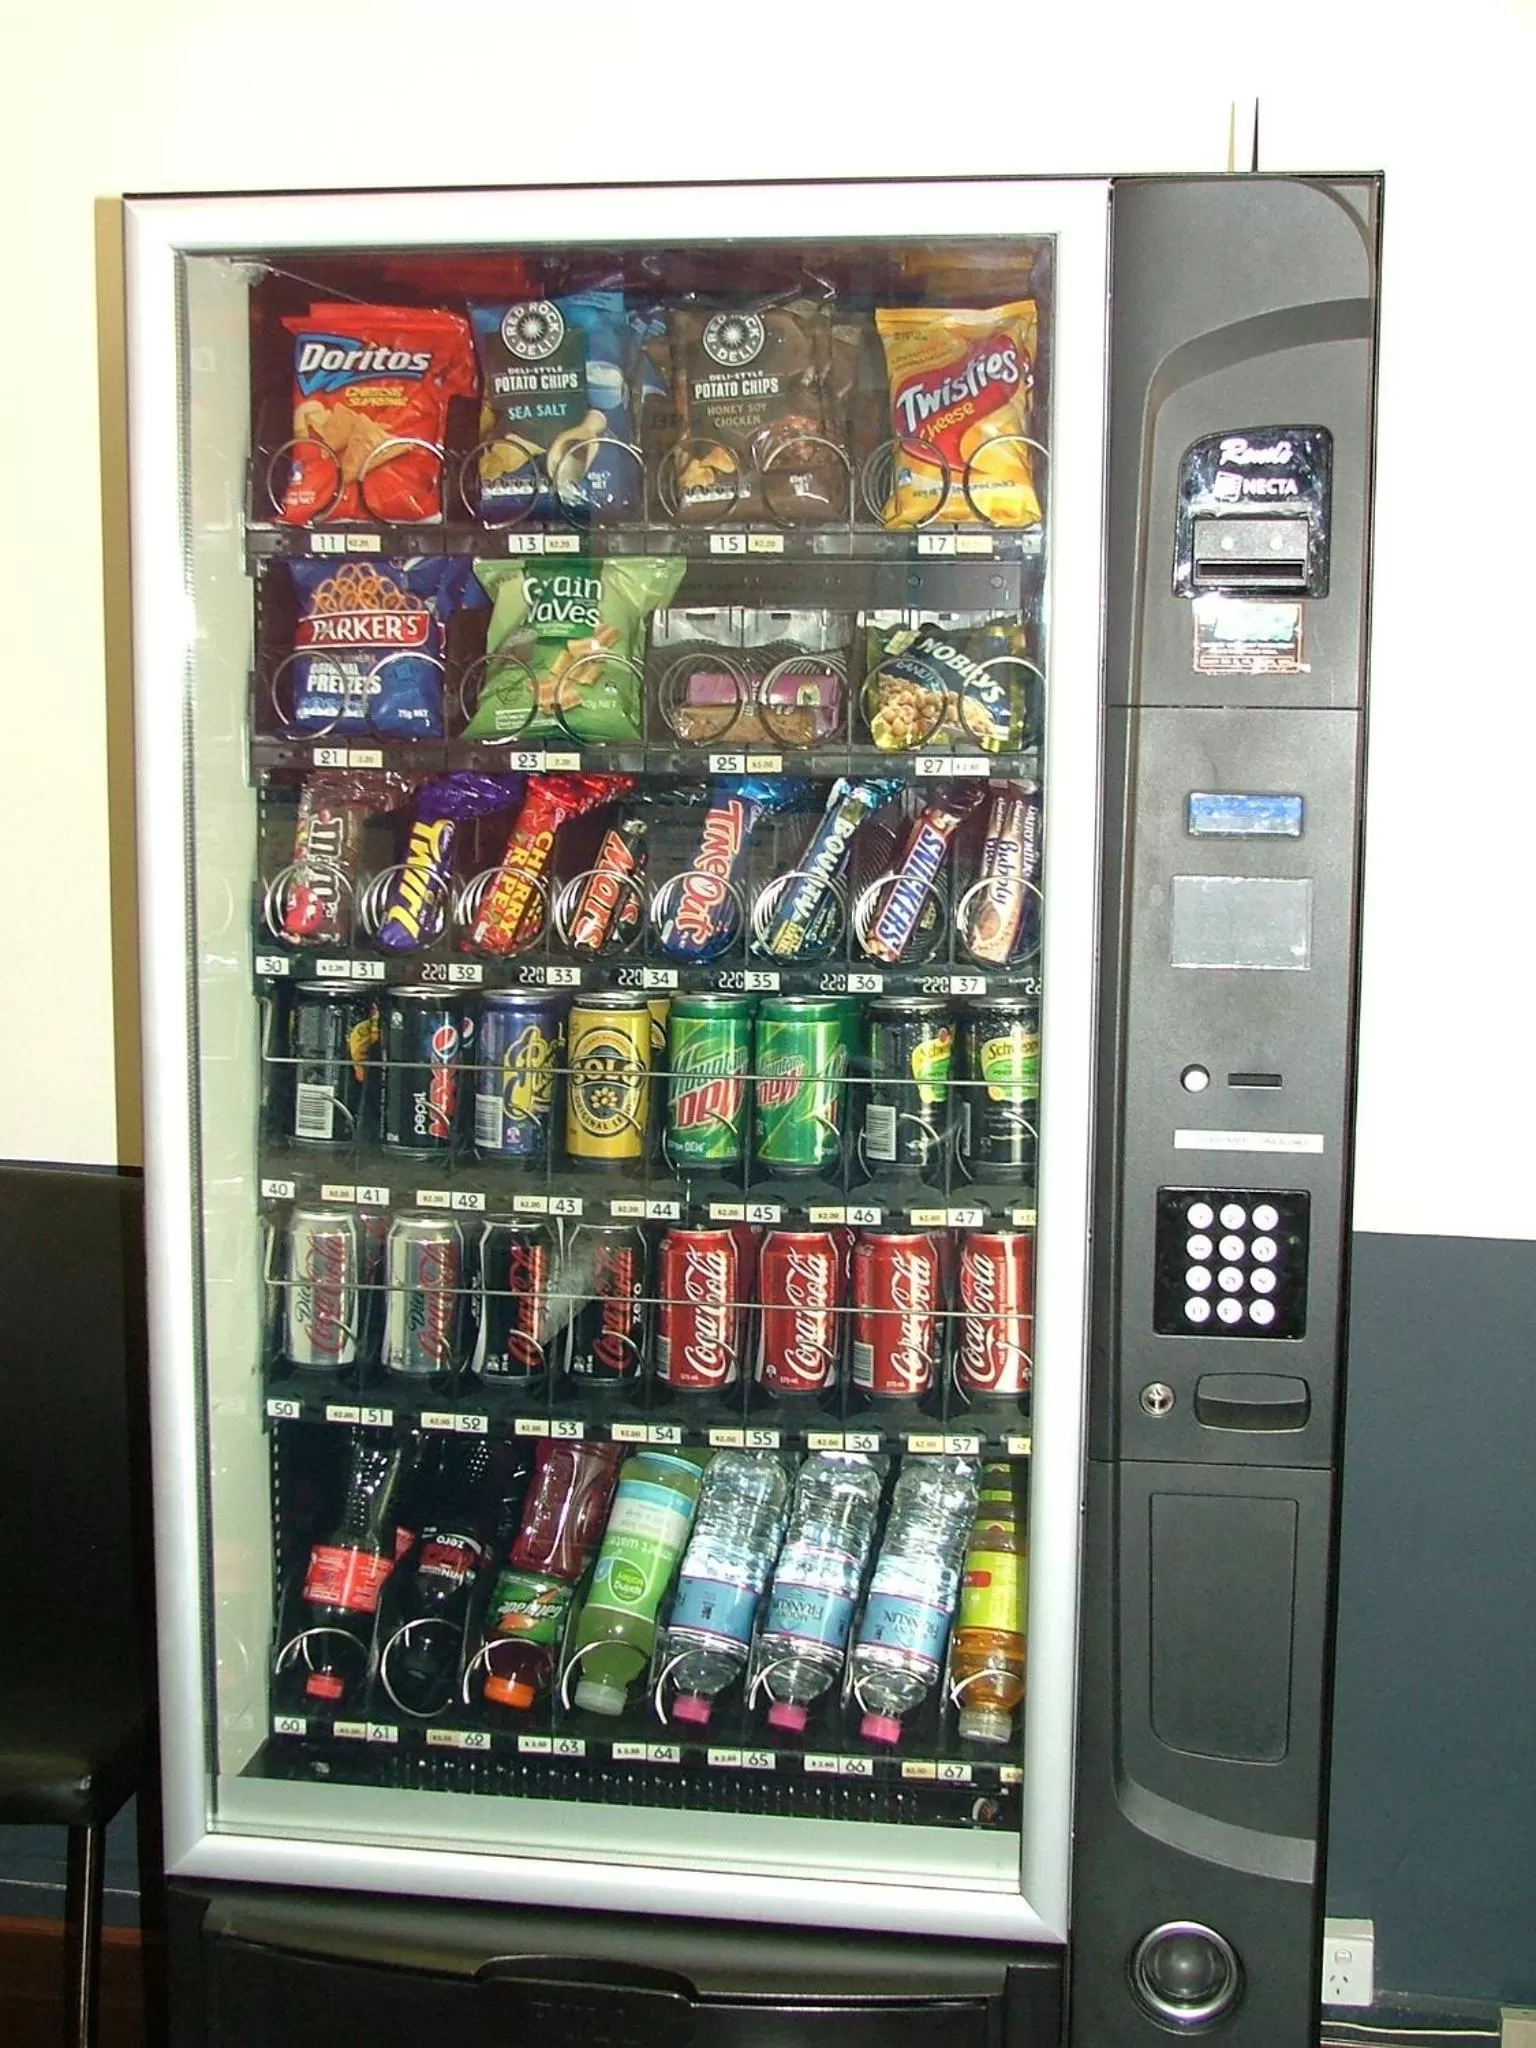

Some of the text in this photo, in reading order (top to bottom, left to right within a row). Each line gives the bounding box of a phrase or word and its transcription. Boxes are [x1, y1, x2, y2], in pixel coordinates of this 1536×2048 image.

[529, 302, 560, 332] ROCK
[515, 339, 553, 356] DELI
[717, 345, 754, 362] DELI
[298, 343, 432, 373] Doritos
[494, 373, 578, 393] POTATO CHIPS
[694, 377, 779, 399] POTATO CHIPS
[896, 350, 1018, 433] Twisties
[508, 403, 567, 421] SEA SALT
[706, 404, 744, 416] HONEY
[1242, 478, 1299, 496] NECTA
[319, 536, 337, 551] 11
[516, 536, 538, 552] 13
[719, 537, 739, 551] 15
[927, 537, 947, 551] 17
[311, 615, 418, 641] PARKER'S
[320, 750, 338, 765] 21
[518, 752, 538, 768] 23
[716, 756, 737, 771] 25
[923, 758, 943, 774] 27
[876, 827, 946, 951] SNICKERS
[264, 959, 282, 974] 30
[358, 961, 376, 976] 31
[456, 965, 475, 980] 32
[554, 968, 574, 983] 33
[652, 972, 671, 986] 34
[753, 973, 773, 988] 35
[855, 976, 876, 990] 36
[960, 977, 979, 992] 37
[572, 1059, 641, 1087] SOLO
[413, 1092, 427, 1135] pepsi
[268, 1182, 288, 1196] 40
[362, 1187, 380, 1202] 41
[458, 1193, 478, 1208] 42
[555, 1197, 576, 1213] 43
[652, 1203, 672, 1216] 44
[753, 1206, 774, 1220] 45
[853, 1209, 874, 1223] 46
[955, 1210, 975, 1225] 47
[633, 1282, 643, 1324] zeo
[274, 1403, 293, 1416] 50
[368, 1408, 386, 1423] 51
[462, 1416, 481, 1432] 52
[558, 1422, 578, 1437] 53
[655, 1428, 674, 1442] 54
[752, 1432, 773, 1446] 55
[853, 1436, 873, 1451] 56
[952, 1438, 972, 1452] 57
[436, 1535, 465, 1550] zero
[280, 1718, 300, 1732] 60
[373, 1725, 391, 1740] 61
[464, 1732, 484, 1747] 62
[559, 1739, 579, 1754] 63
[654, 1746, 673, 1760] 64
[749, 1752, 769, 1767] 65
[845, 1758, 865, 1773] 66
[944, 1765, 964, 1779] 67
